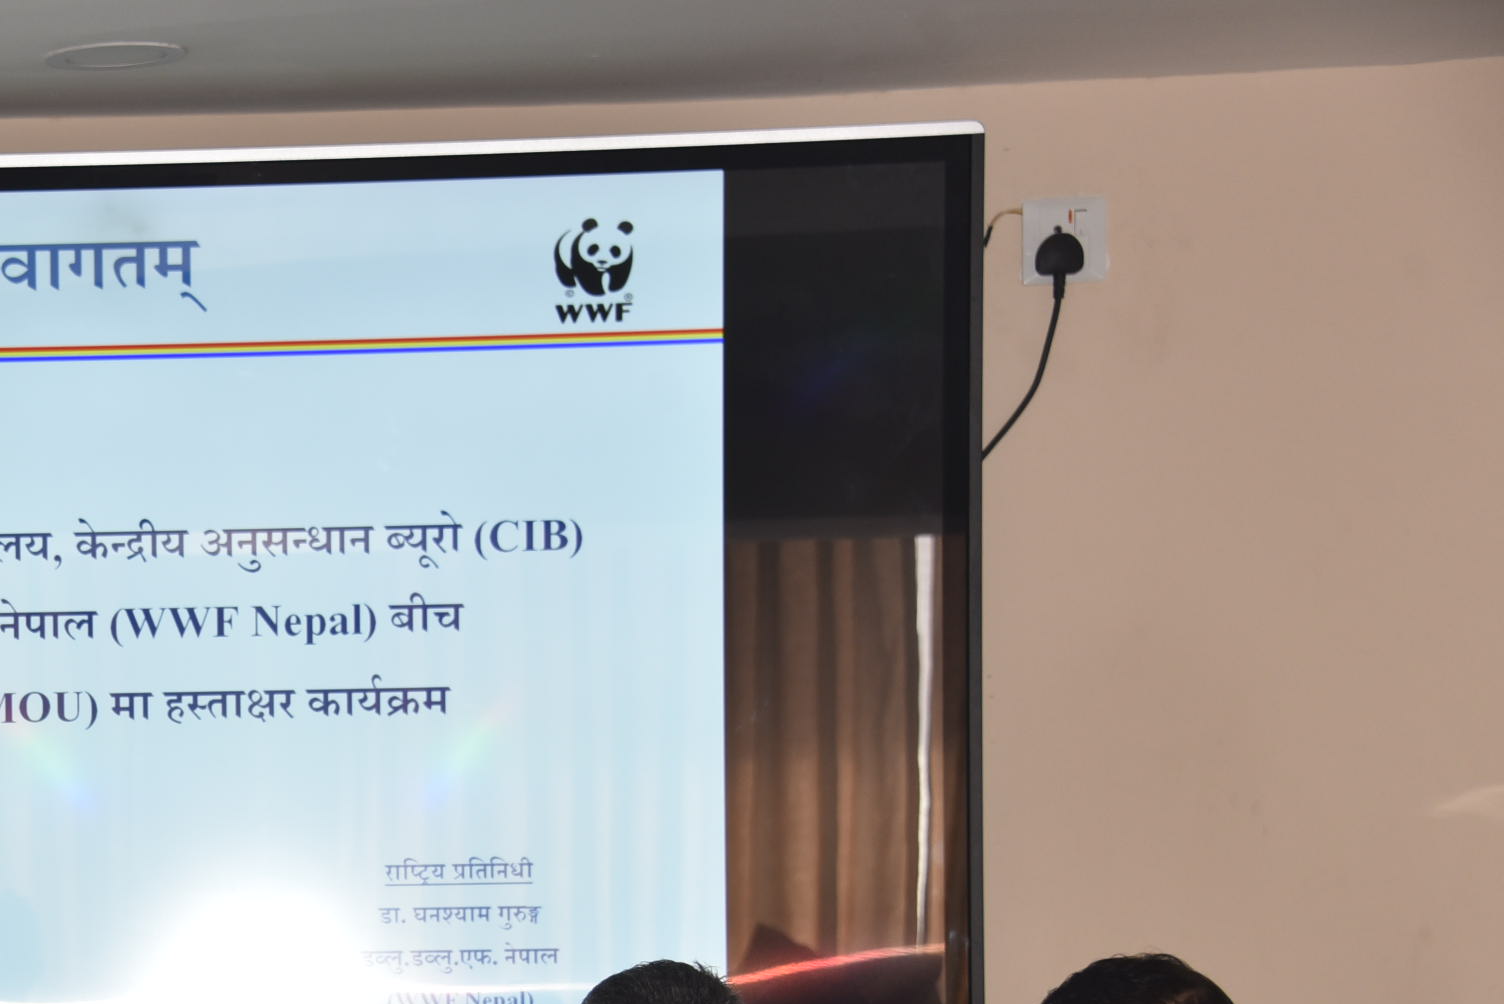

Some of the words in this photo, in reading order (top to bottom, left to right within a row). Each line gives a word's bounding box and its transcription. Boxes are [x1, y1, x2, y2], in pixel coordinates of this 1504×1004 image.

[556, 303, 632, 323] WWF
[74, 518, 189, 562] केन्द्रीय
[202, 526, 374, 571] अनुसन्धान
[384, 510, 462, 568] ब्यूरो
[475, 520, 582, 558] (CIB)
[111, 607, 238, 646] (WWF
[253, 604, 376, 645] Nepal)
[389, 593, 464, 631] बीच
[110, 692, 153, 719] मा
[163, 690, 295, 724] हस्ताक्षर
[306, 674, 450, 716] कार्यक्रम
[452, 856, 534, 882] प्रतिनिधी
[378, 908, 406, 924] डा.
[414, 906, 491, 922] घनश्याम
[504, 942, 559, 964] नेपाल
